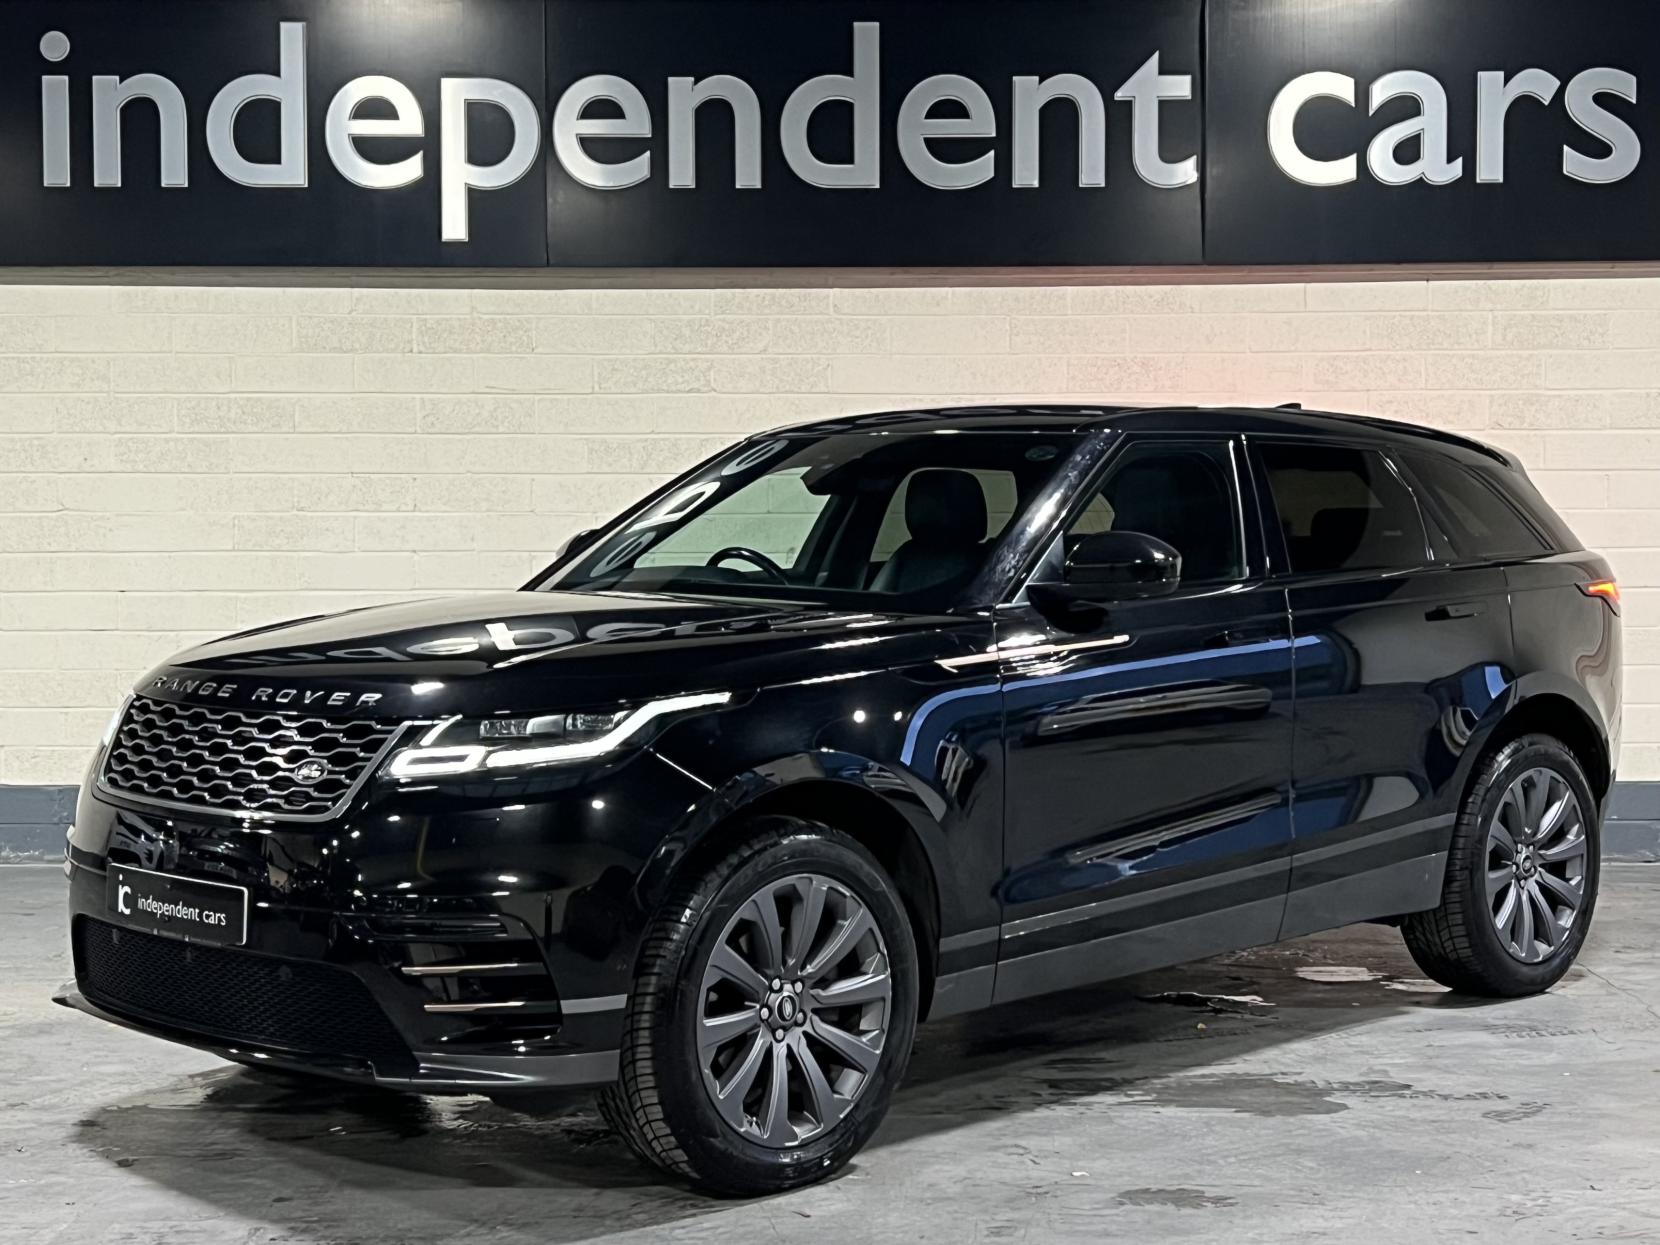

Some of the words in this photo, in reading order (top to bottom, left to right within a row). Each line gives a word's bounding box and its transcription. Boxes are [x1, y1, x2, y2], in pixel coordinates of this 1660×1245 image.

[40, 21, 1199, 243] independent
[1267, 68, 1642, 187] cars
[152, 676, 238, 697] RANGE
[252, 687, 382, 706] ROVER
[138, 894, 200, 921] independent
[202, 910, 226, 926] cars
